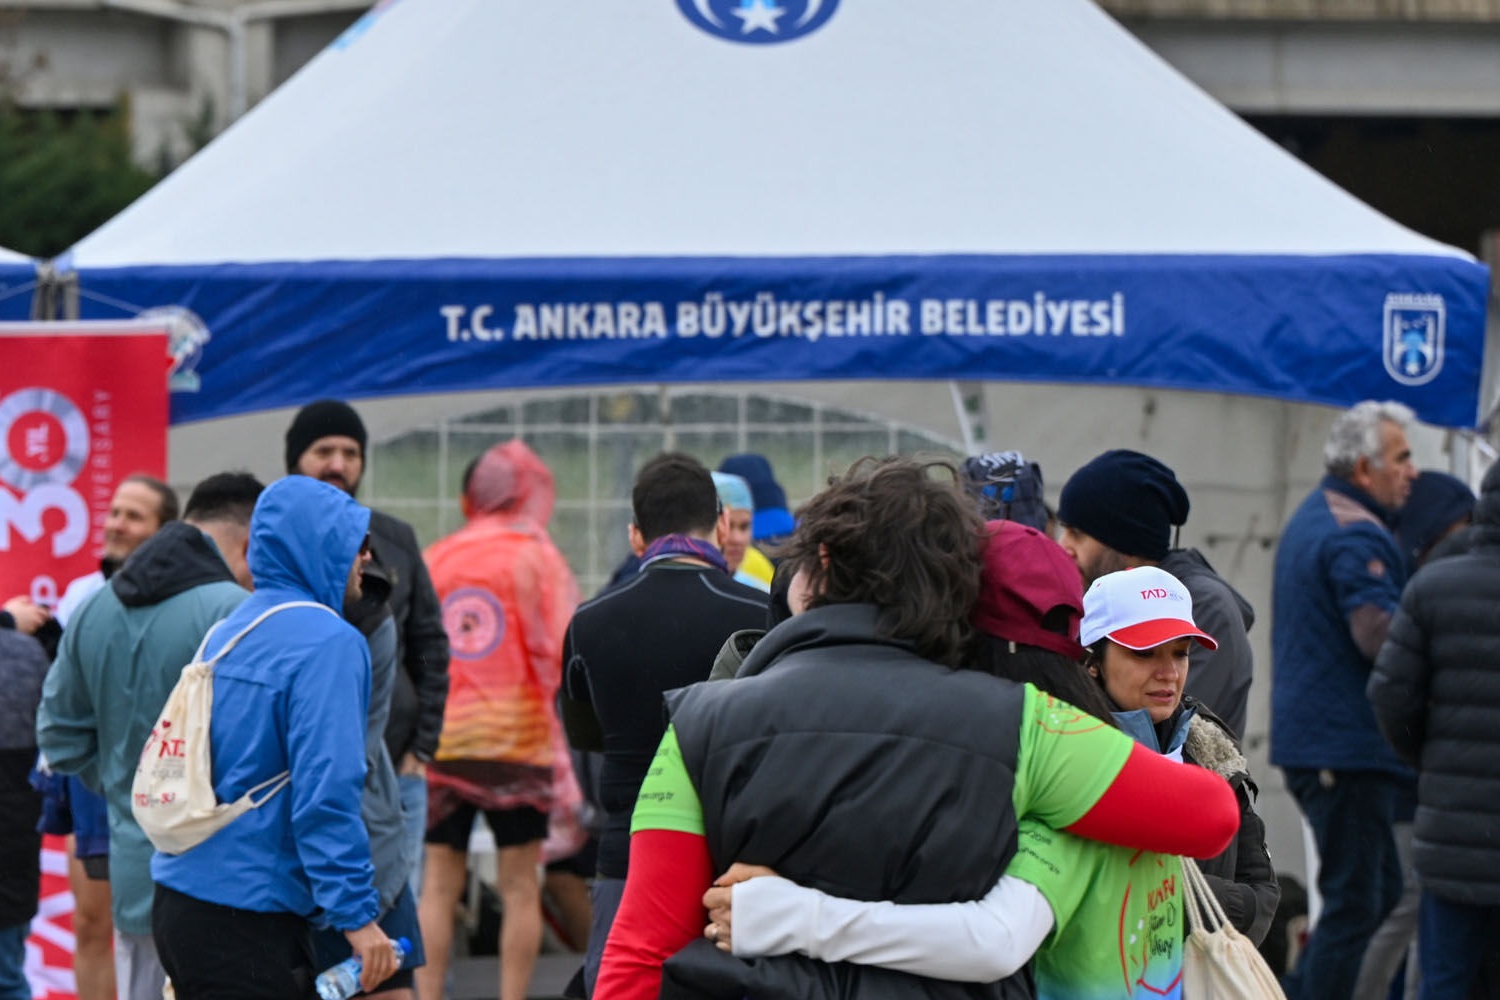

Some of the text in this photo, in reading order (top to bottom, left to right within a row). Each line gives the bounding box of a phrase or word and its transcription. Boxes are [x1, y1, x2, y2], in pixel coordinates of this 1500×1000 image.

[440, 292, 1126, 342] T.C. ANKARA BÜYÜKŞEHİR BELEDİYESİ
